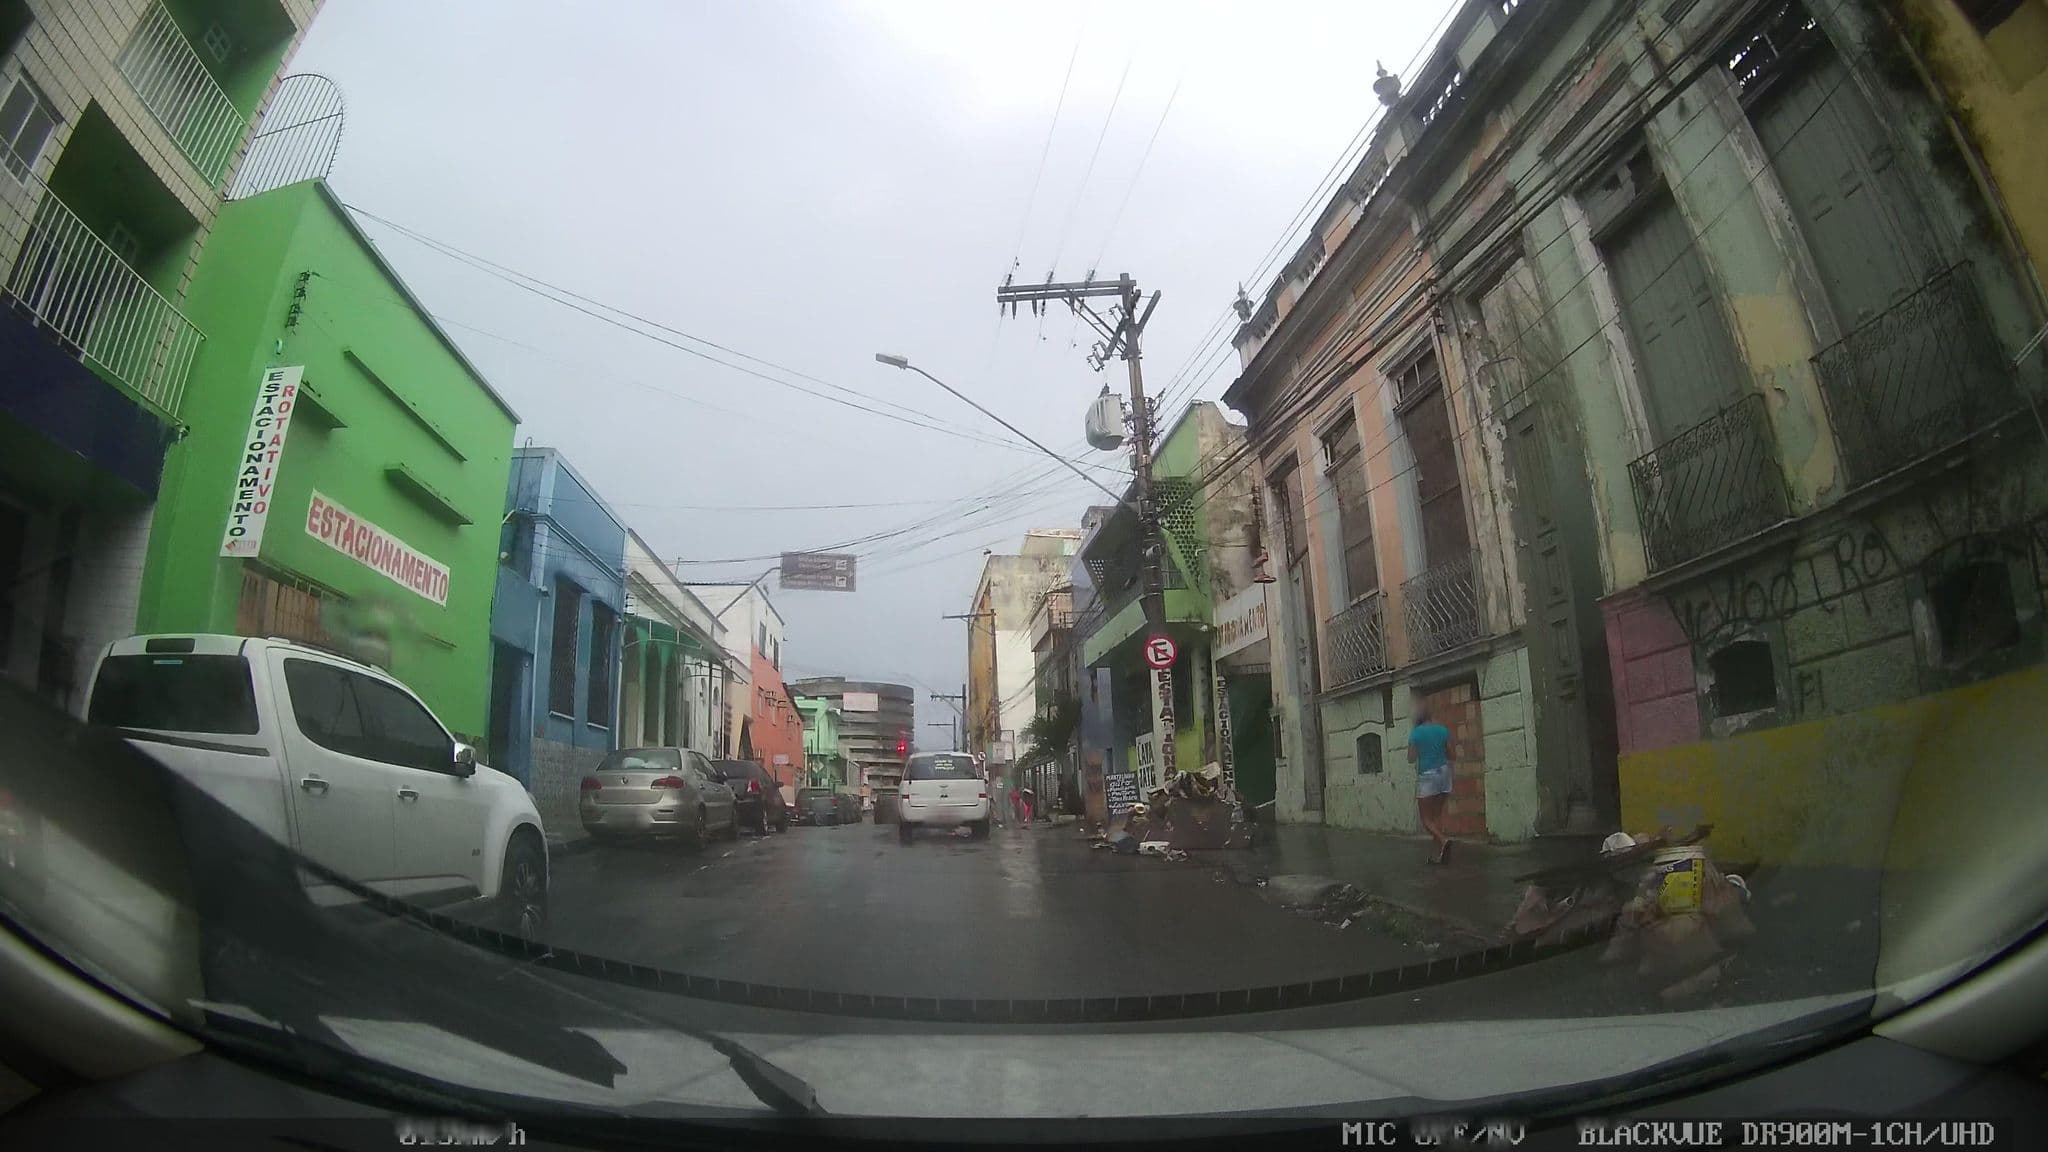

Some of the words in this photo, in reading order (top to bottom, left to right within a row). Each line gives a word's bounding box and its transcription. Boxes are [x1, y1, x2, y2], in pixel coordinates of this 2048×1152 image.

[229, 371, 284, 537] ESTACIONAMENTO
[253, 385, 295, 514] ROTATIVO
[308, 496, 448, 602] ESTACIONAMENTO
[1152, 641, 1170, 662] E
